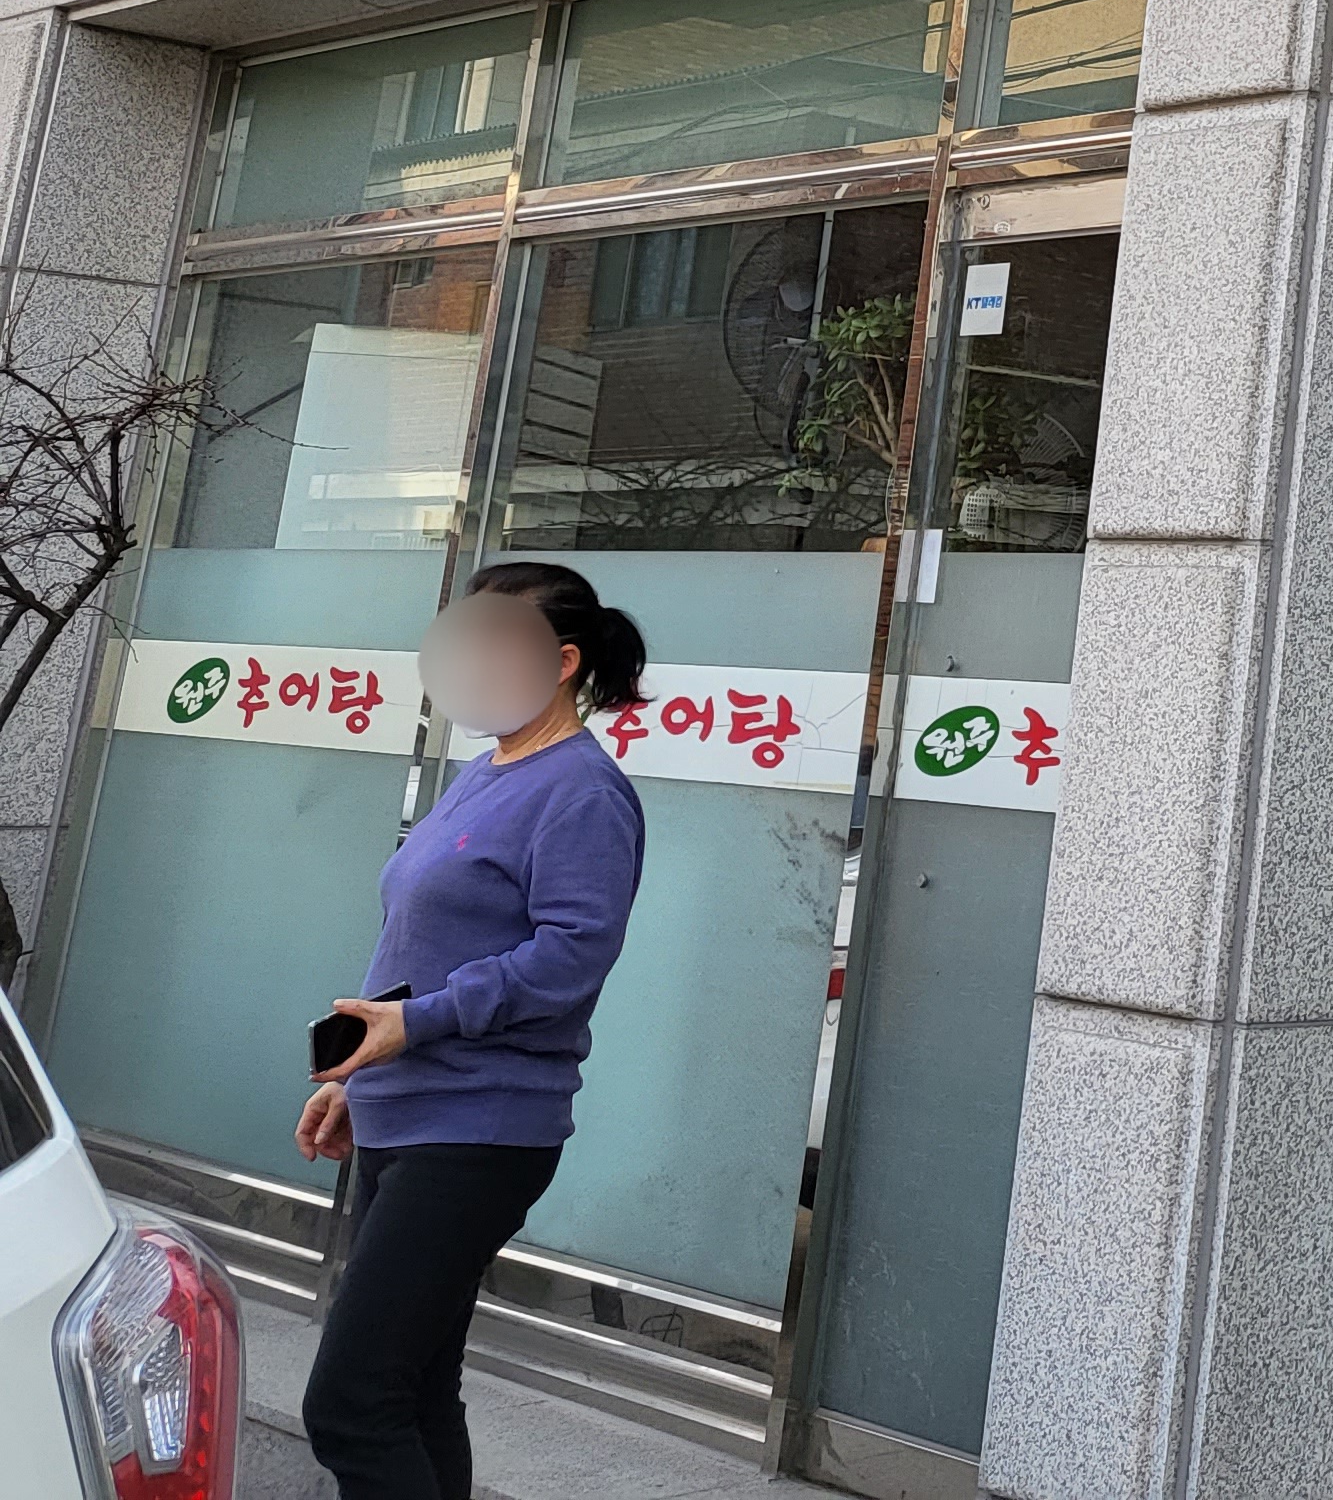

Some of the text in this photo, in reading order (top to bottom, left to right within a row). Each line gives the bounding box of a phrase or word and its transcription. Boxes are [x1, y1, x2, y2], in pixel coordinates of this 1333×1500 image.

[174, 656, 384, 734] 원주 추어탕
[922, 715, 996, 769] 원주
